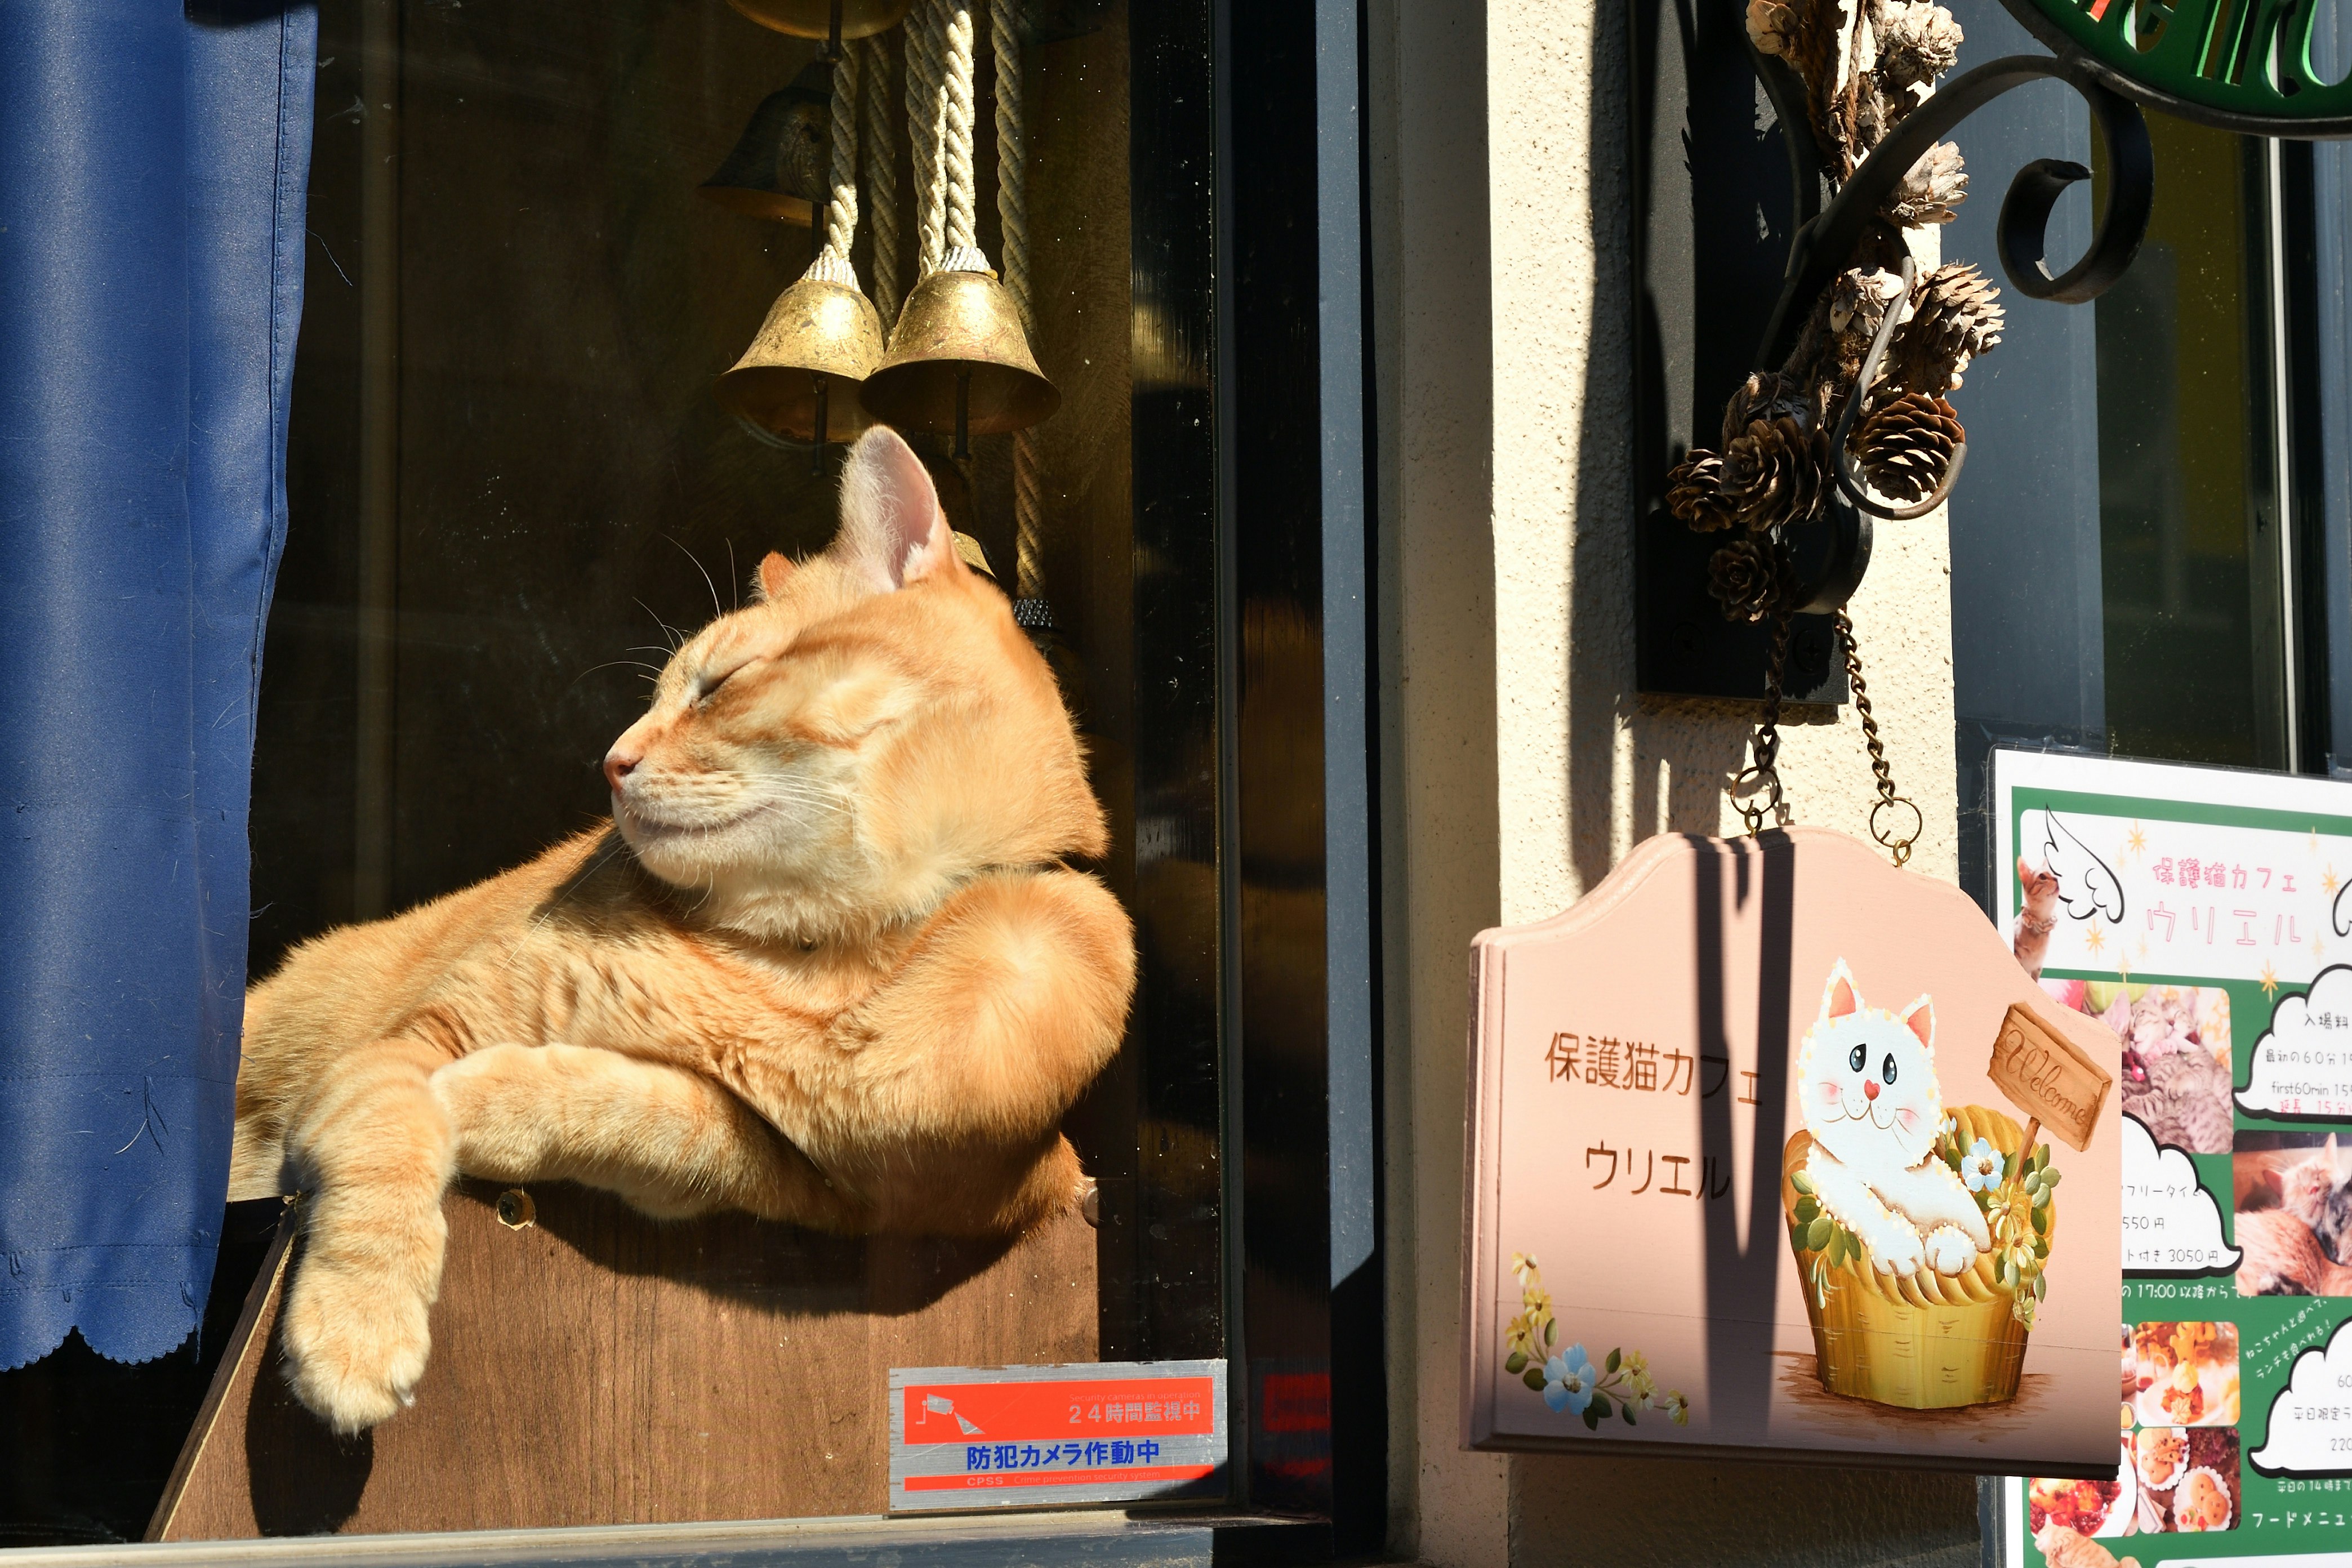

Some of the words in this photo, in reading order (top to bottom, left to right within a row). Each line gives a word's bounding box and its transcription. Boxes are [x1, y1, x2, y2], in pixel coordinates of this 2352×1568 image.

[2152, 857, 2297, 893] 保護猫カフェ
[2146, 901, 2302, 946] ウリエル
[2305, 1012, 2349, 1030] 入場料
[1544, 1031, 1763, 1106] 保護猫カフェ
[2004, 1028, 2087, 1125] Welcome
[1585, 1139, 1731, 1200] ウリエル
[2122, 1184, 2202, 1198] フリータイム
[1069, 1393, 1106, 1402] Security
[1157, 1391, 1201, 1401] operation
[966, 1439, 1160, 1471] 防犯カメラ作動中
[966, 1476, 1004, 1486] CPSS
[1014, 1475, 1041, 1485] Crime
[1043, 1473, 1092, 1486] prevention
[1093, 1472, 1129, 1483] security
[1130, 1471, 1160, 1482] system
[2252, 1511, 2352, 1529] フードメニュ
